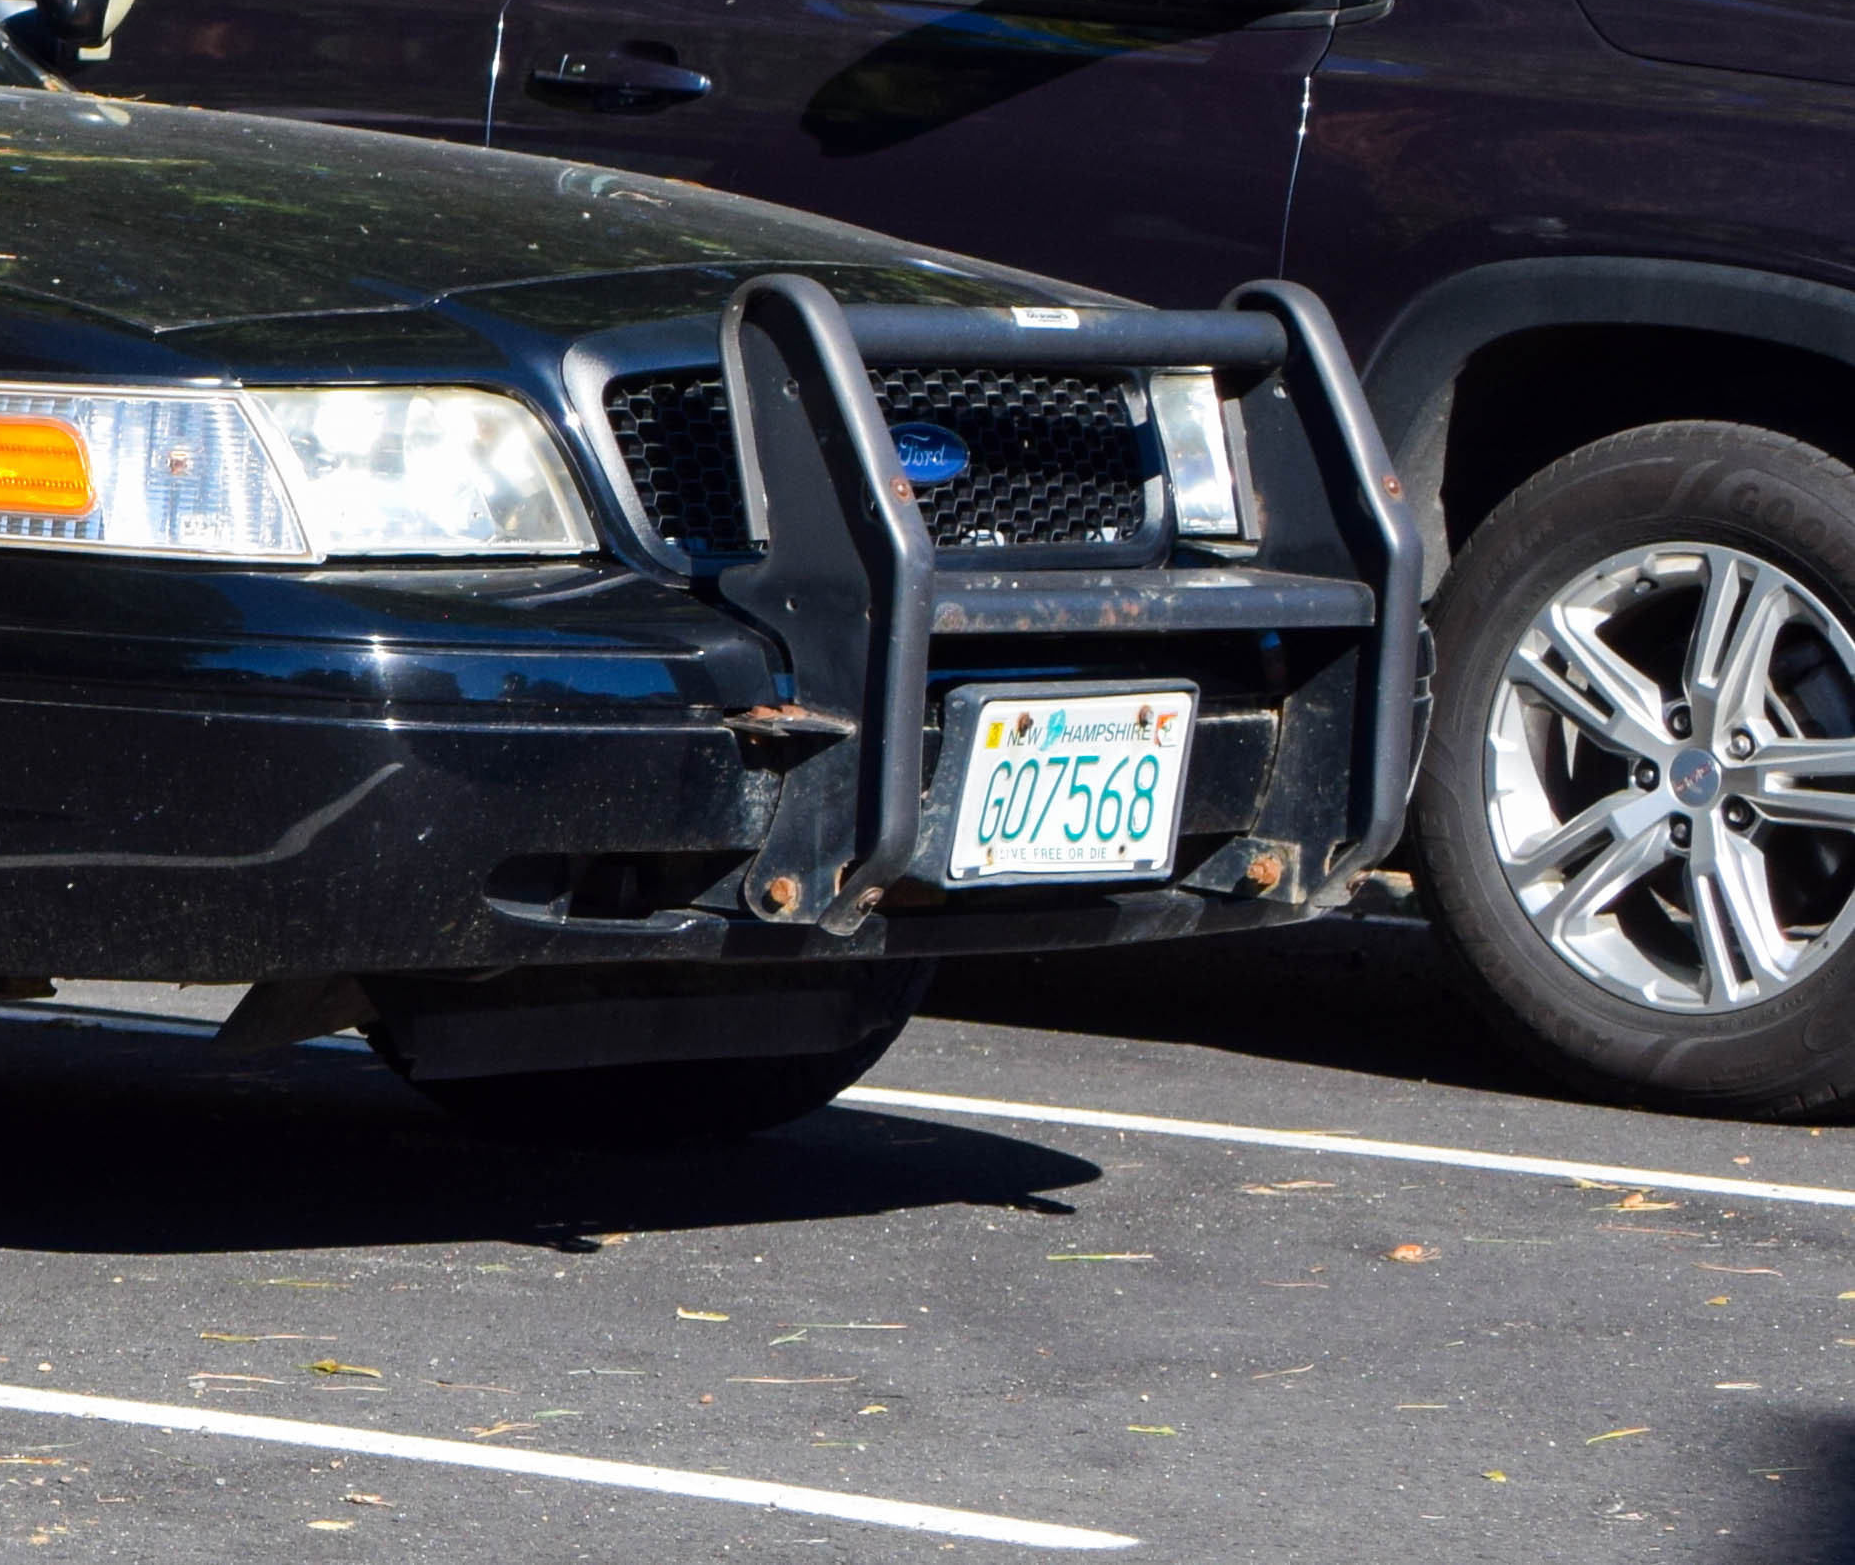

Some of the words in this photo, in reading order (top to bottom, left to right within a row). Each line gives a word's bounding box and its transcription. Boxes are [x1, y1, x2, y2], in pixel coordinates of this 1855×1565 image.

[898, 433, 946, 467] Ford
[1007, 726, 1043, 748] NEW
[1060, 721, 1152, 743] HAMPSHIRE
[977, 753, 1161, 845] G07568
[1033, 847, 1062, 861] FREE
[1068, 847, 1084, 860] OR
[1090, 846, 1108, 860] DIE
